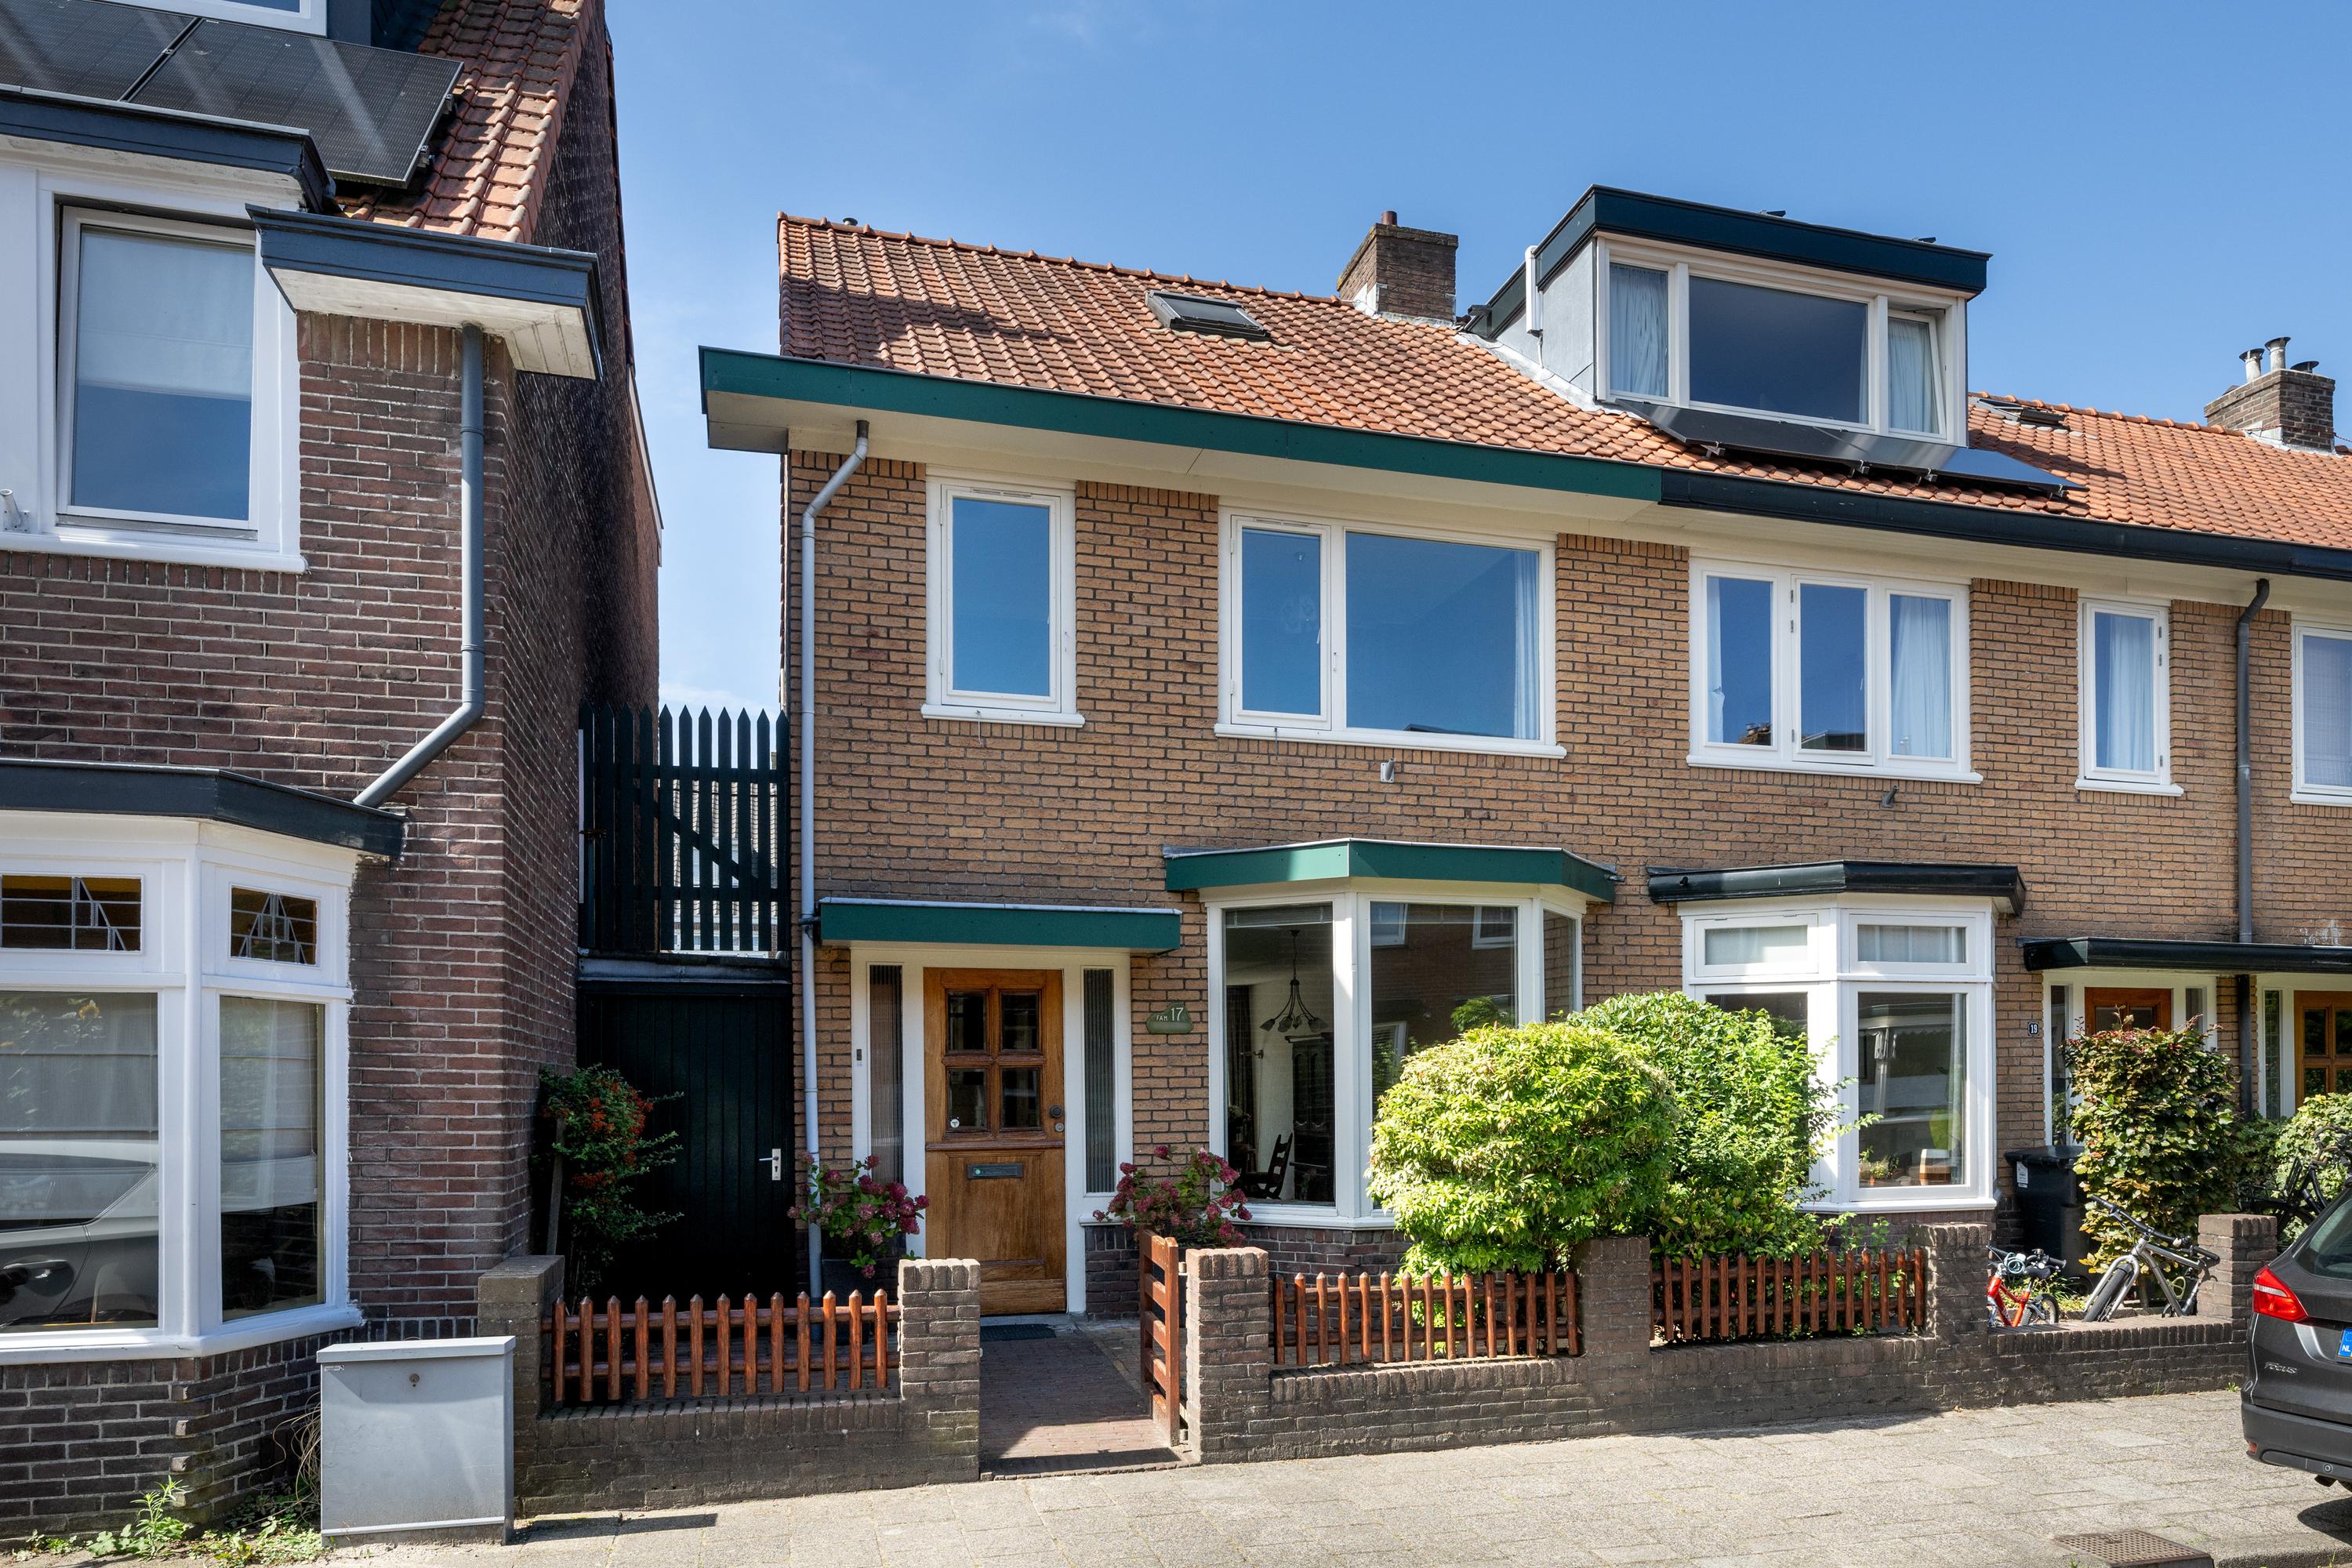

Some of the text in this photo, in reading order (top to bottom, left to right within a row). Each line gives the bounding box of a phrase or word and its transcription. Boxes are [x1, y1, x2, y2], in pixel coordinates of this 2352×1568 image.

[1171, 1007, 1184, 1022] 17
[2031, 1024, 2038, 1034] 19
[2341, 1344, 2351, 1352] NL
